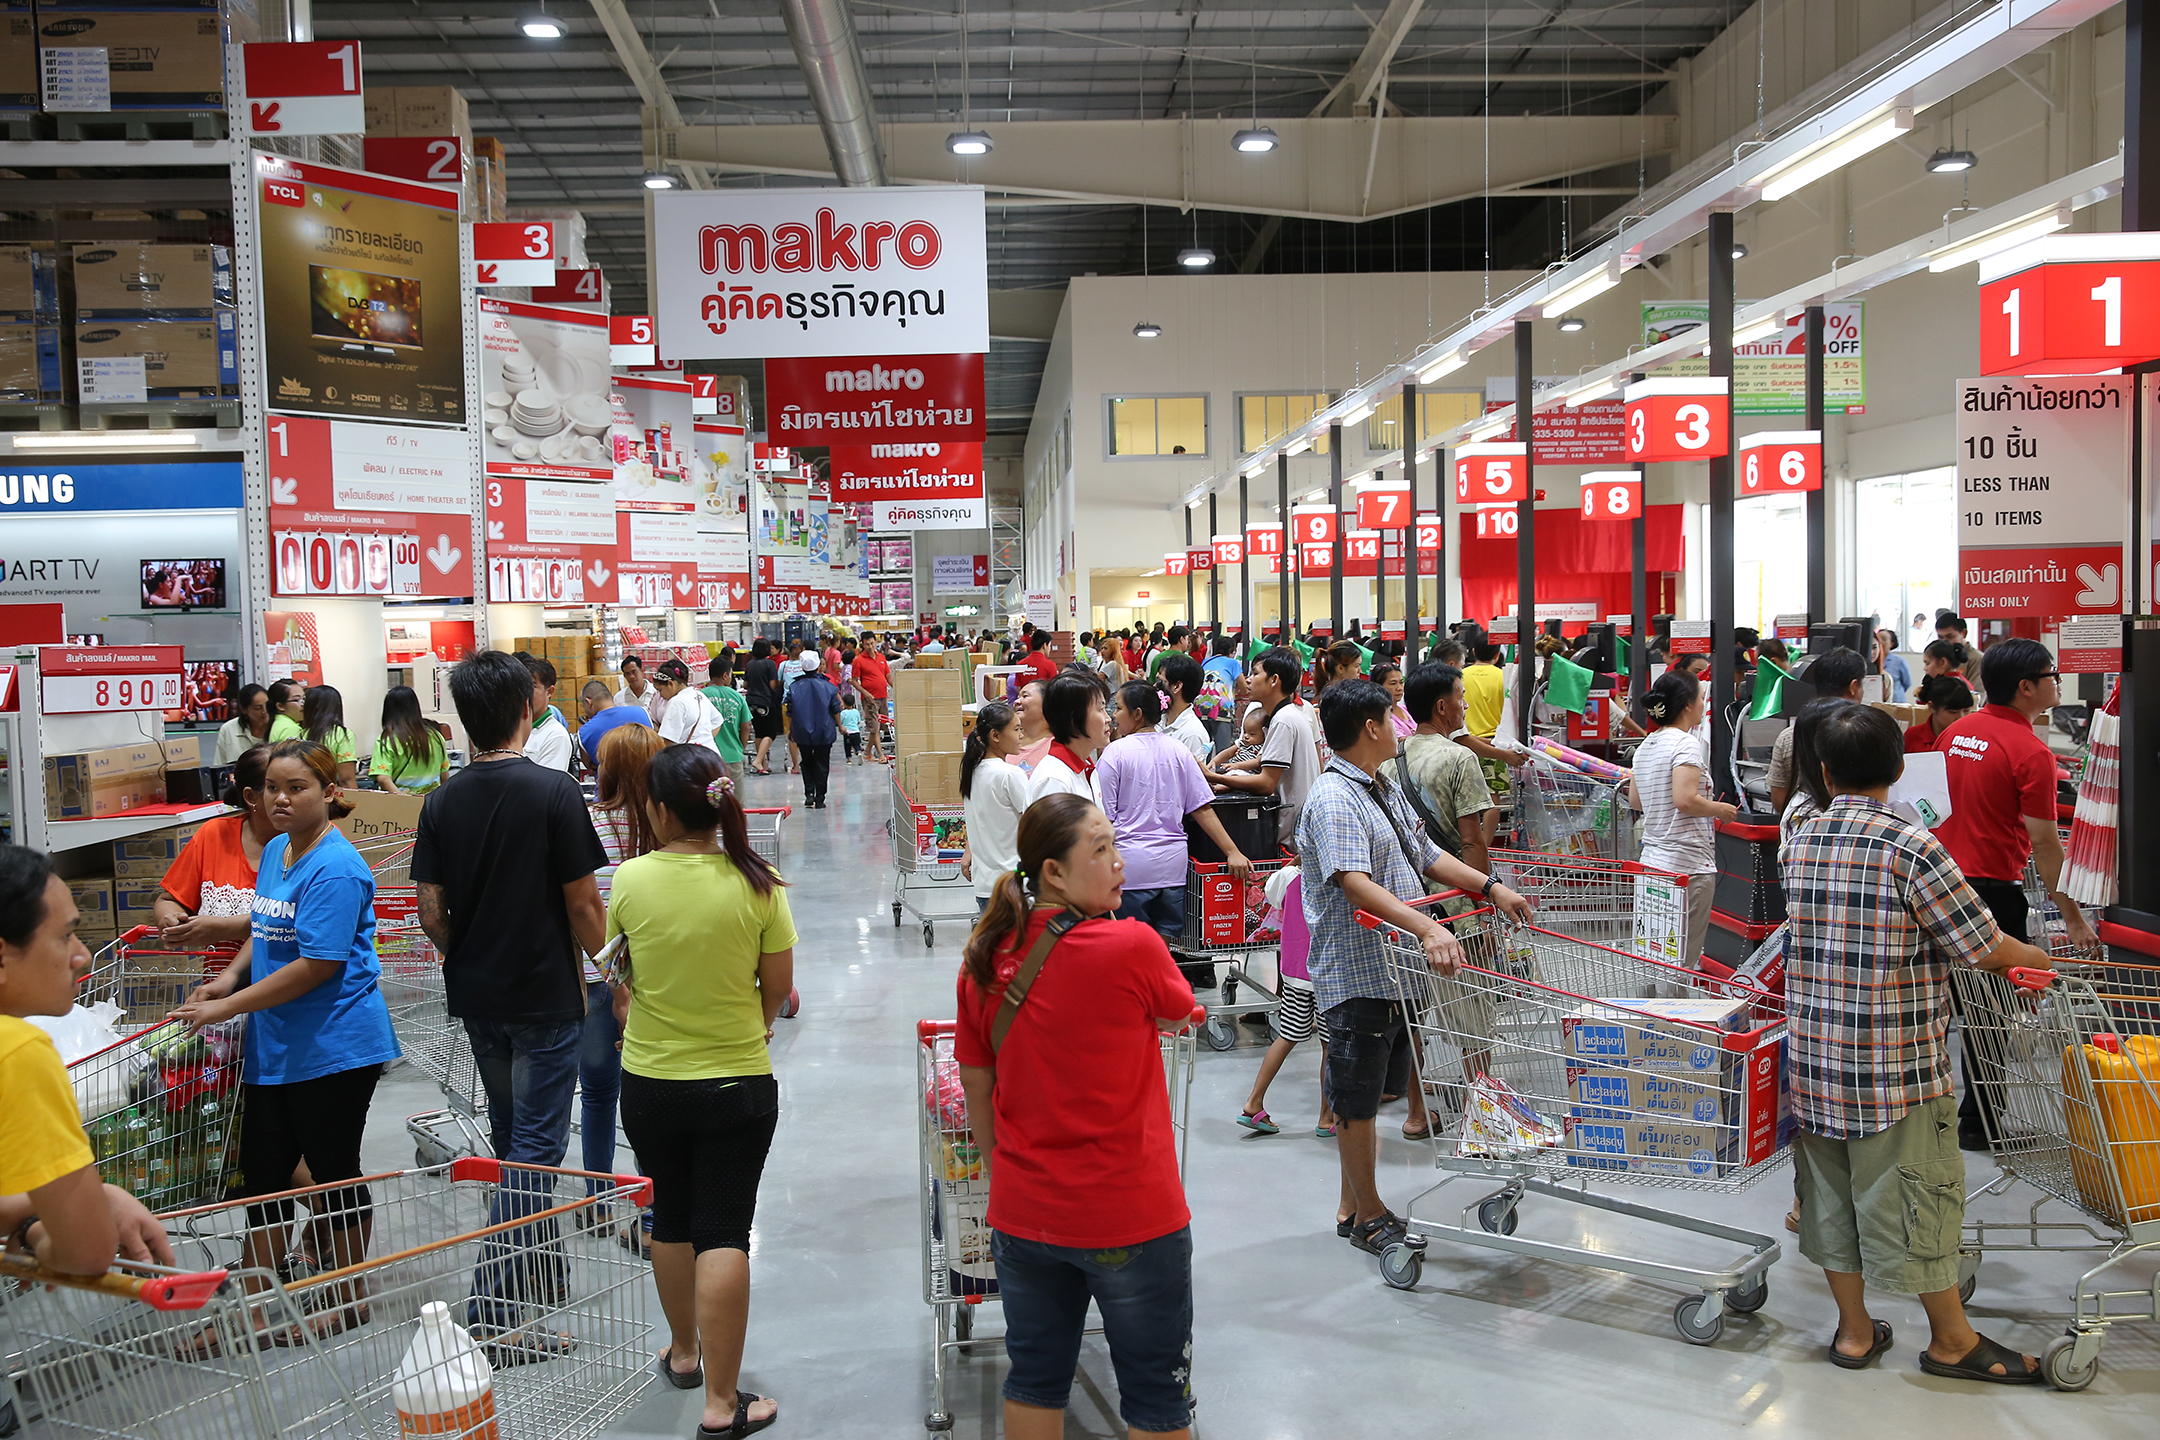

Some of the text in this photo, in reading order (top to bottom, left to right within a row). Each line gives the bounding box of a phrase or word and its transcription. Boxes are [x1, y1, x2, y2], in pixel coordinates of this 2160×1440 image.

[48, 24, 90, 32] SAMSUNG
[143, 47, 160, 60] TV
[328, 45, 355, 91] 1
[204, 93, 222, 103] 40
[427, 140, 458, 179] 2
[269, 184, 300, 201] TCL
[523, 225, 550, 258] 3
[699, 207, 942, 275] makro
[575, 271, 598, 299] 4
[348, 297, 385, 312] DVB T2
[701, 280, 945, 335] คู่คิดธุรกิจคุณ
[2091, 276, 2122, 346] 1
[494, 321, 509, 329] aro
[631, 318, 651, 343] 5
[2002, 288, 2020, 357] 1
[1829, 341, 1859, 354] OFF
[698, 376, 715, 396] 7
[825, 363, 925, 393] makro
[718, 394, 733, 414] 8
[1964, 382, 2120, 412] สินค้าน้อยกว่า
[780, 399, 973, 430] มิตรแท้โชห่วย
[1631, 408, 1645, 454] 3
[1675, 404, 1710, 449] 3
[271, 422, 288, 457] 1
[1964, 426, 2037, 459] 10 ชิ้น
[871, 442, 941, 459] makro
[399, 468, 428, 476] ELECTRIC
[431, 469, 443, 477] FAN
[1485, 461, 1512, 495] 5
[1746, 453, 1758, 488] 6
[1779, 451, 1805, 485] 6
[839, 468, 975, 490] มิตรแท้โชห่วย
[1458, 464, 1467, 497] 5
[1964, 476, 2050, 492] LESS THAN
[428, 496, 454, 505] THEATER
[456, 497, 467, 505] SET
[488, 482, 503, 507] 3
[1584, 488, 1593, 516] 8
[1608, 487, 1630, 514] 8
[888, 507, 972, 525] คู่คิดธุรกิจคุณ
[1377, 495, 1398, 522] 7
[1965, 511, 2042, 526] 10 ITEMS
[1310, 517, 1327, 540] 9
[1491, 511, 1518, 534] 10
[1258, 532, 1276, 552] 11
[1355, 540, 1377, 558] 14
[1191, 554, 1210, 568] 15
[1218, 544, 1240, 561] 13
[1311, 549, 1330, 566] 16
[69, 559, 100, 580] TV
[1168, 560, 1186, 574] 17
[1964, 559, 2067, 585] เงินสดเท่านั้น
[45, 589, 84, 598] experience
[768, 593, 789, 611] 359
[1965, 596, 2029, 608] CASH ONLY
[1952, 735, 1989, 751] makro
[353, 818, 378, 835] Pro
[1764, 968, 1777, 982] NEXT
[1576, 1030, 1624, 1052] Lactasoy
[1695, 1048, 1711, 1059] 10
[1760, 1060, 1770, 1071] aro
[1580, 1080, 1627, 1102] Lactasoy
[1698, 1101, 1713, 1112] 10
[1577, 1128, 1624, 1150] Lactasoy
[1754, 1123, 1771, 1139] DRINKING
[1755, 1138, 1767, 1152] WATER
